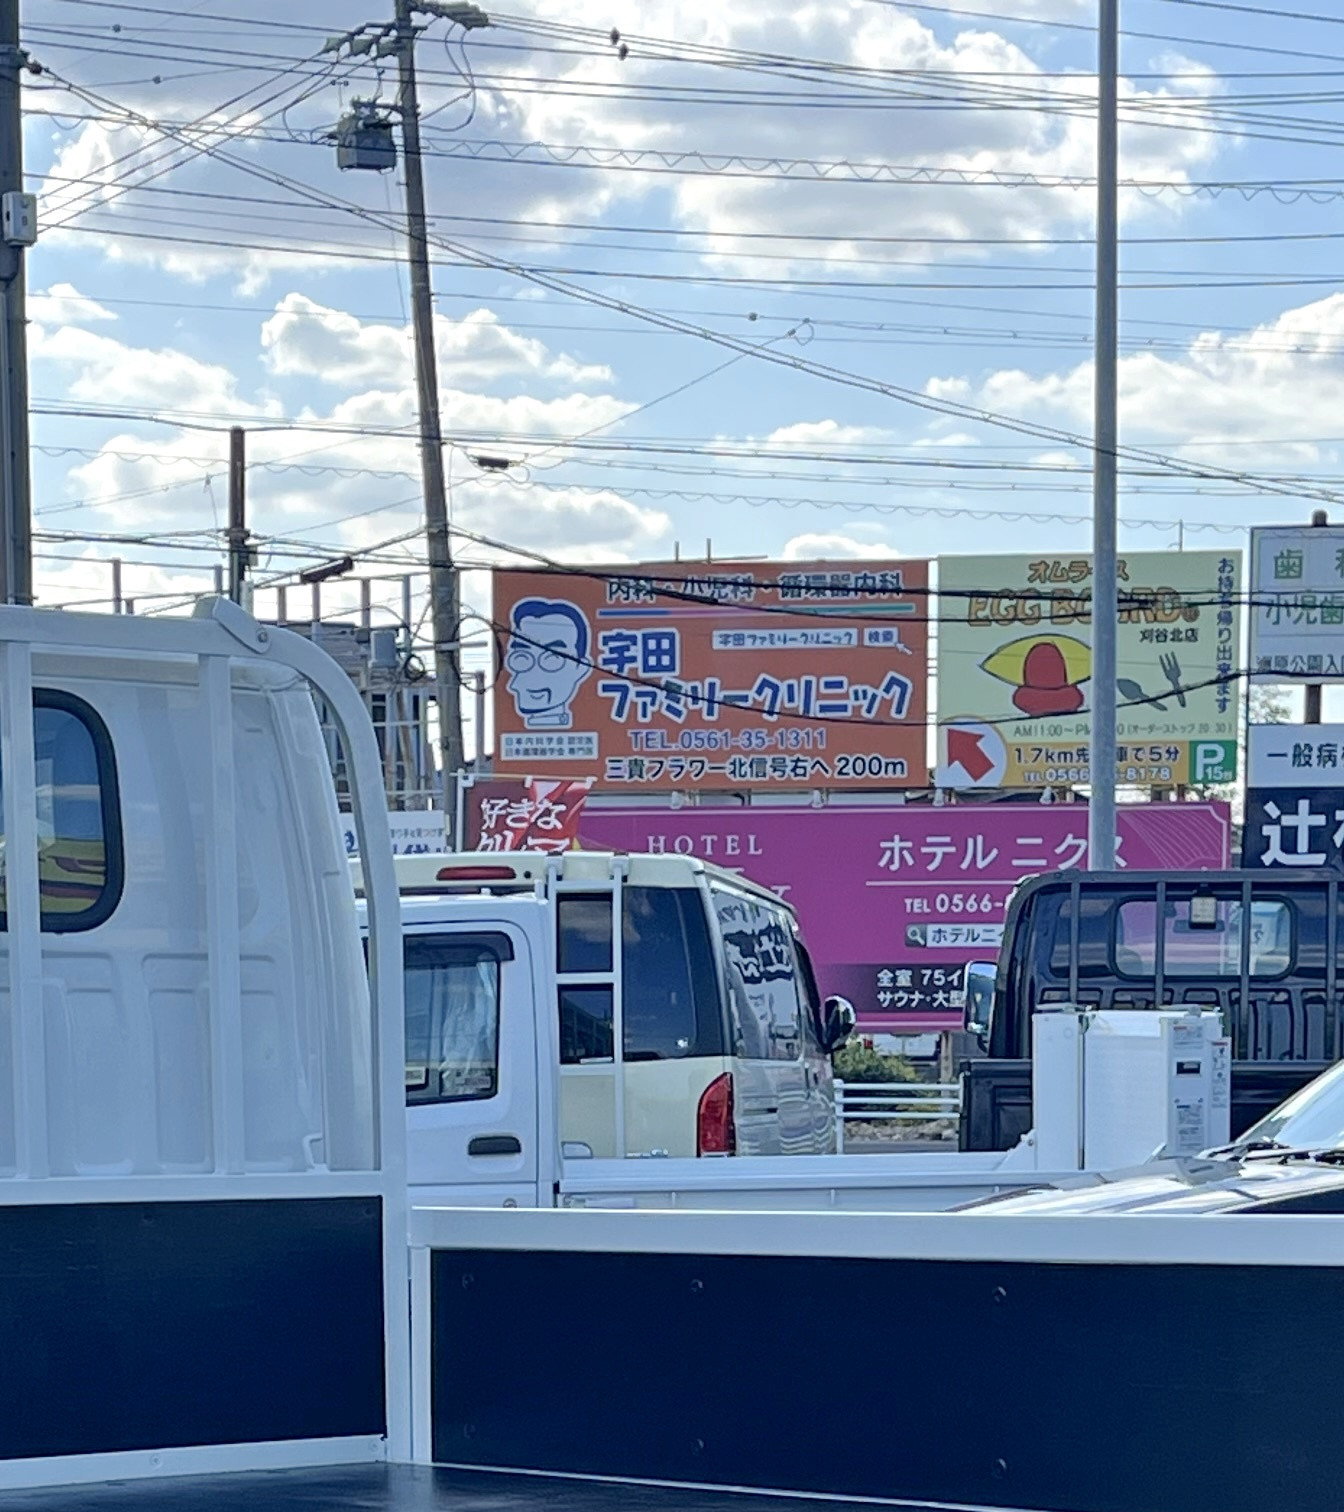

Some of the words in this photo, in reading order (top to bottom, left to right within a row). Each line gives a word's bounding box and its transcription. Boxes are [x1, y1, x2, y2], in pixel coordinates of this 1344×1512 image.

[600, 630, 679, 675] 宇田
[599, 673, 912, 722] ファミリークリニック
[480, 798, 568, 830] 好きな
[647, 834, 764, 856] HOTEL
[905, 899, 931, 914] TEL
